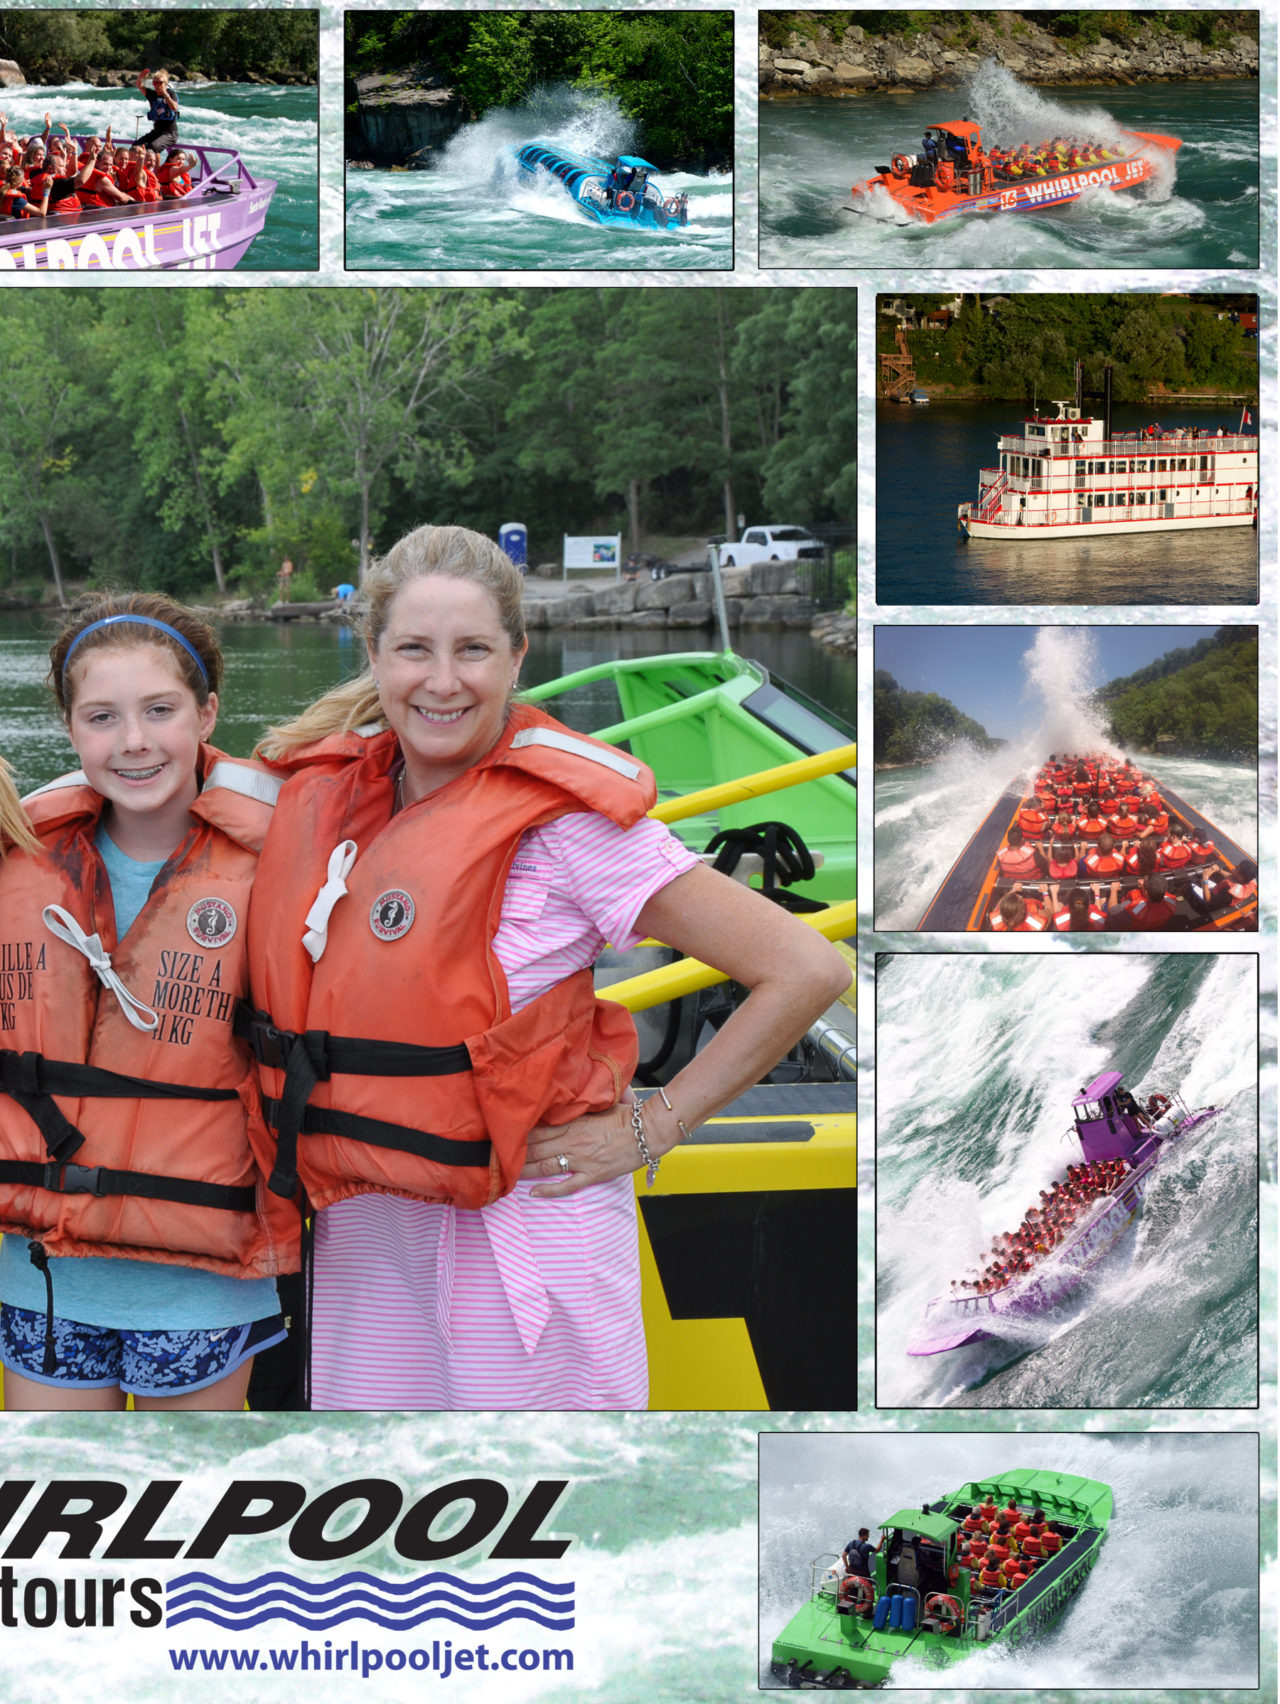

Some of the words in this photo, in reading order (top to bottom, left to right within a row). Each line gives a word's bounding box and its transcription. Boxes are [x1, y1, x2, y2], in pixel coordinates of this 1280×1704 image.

[1001, 191, 1017, 208] 16
[1025, 167, 1120, 203] WHIRLPOOL
[1125, 160, 1145, 181] JET
[177, 212, 222, 269] JET
[36, 942, 46, 970] A
[158, 950, 204, 983] SIZE
[208, 959, 221, 988] A
[18, 971, 34, 1000] DE
[152, 980, 205, 1015] MORE
[206, 989, 234, 1023] TH
[0, 1002, 16, 1030] KG
[168, 1015, 194, 1045] KG
